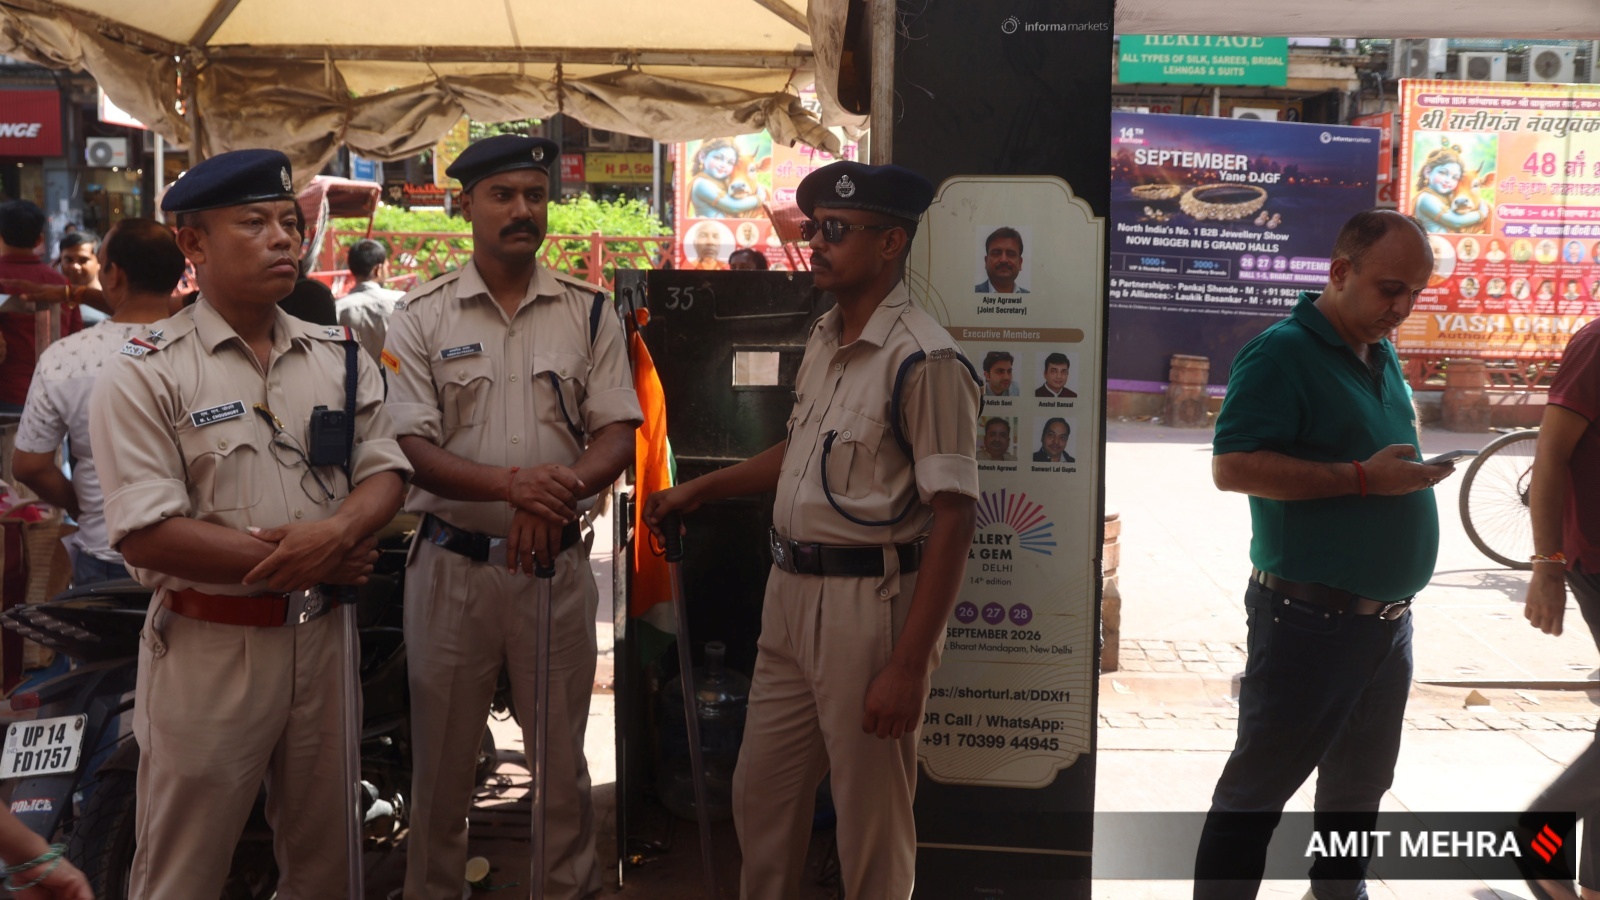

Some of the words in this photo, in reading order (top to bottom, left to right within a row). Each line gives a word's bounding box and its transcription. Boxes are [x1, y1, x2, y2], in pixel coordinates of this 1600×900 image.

[1144, 34, 1264, 48] HERITAGE
[1122, 54, 1138, 62] ALL
[1141, 54, 1170, 63] TYPES
[1172, 54, 1184, 63] OF
[1186, 55, 1210, 65] SILK,
[1212, 56, 1249, 66] SAREES,
[1252, 56, 1284, 66] BRIDAL
[1164, 66, 1206, 75] LEHNGAS
[1208, 67, 1215, 75] &
[1218, 67, 1244, 76] SUITS
[1420, 110, 1444, 129] श्री
[1450, 111, 1521, 132] रानीगंज
[1134, 148, 1248, 170] SEPTEMBER
[1523, 152, 1556, 176] 48
[606, 164, 614, 174] H
[620, 164, 628, 174] P
[634, 163, 653, 174] So
[1220, 170, 1246, 182] Yane
[1249, 172, 1281, 184] DJGF
[1117, 223, 1143, 232] North
[1145, 224, 1174, 234] India's
[1175, 226, 1191, 236] No.
[1193, 228, 1198, 236] 1
[1200, 228, 1218, 237] B2B
[1220, 229, 1261, 240] Jewellery
[1263, 231, 1289, 240] Show
[1126, 236, 1150, 245] NOW
[1152, 238, 1190, 248] BIGGER
[1190, 239, 1202, 248] IN
[1204, 240, 1210, 248] 5
[1212, 240, 1246, 250] GRAND
[1248, 242, 1280, 252] HALLS
[1241, 258, 1254, 267] 26
[1256, 258, 1270, 268] 27
[1274, 259, 1286, 268] 28
[1290, 260, 1330, 271] SEPTEMB
[1178, 282, 1206, 293] Pankaj
[1207, 284, 1238, 294] Shende
[1245, 286, 1254, 294] M
[1262, 288, 1278, 296] +91
[665, 286, 695, 310] 35
[982, 296, 996, 304] Ajay
[998, 297, 1022, 306] Agrawal
[1110, 290, 1120, 298] ng
[1122, 289, 1128, 297] &
[1175, 292, 1203, 301] Laukik
[1204, 294, 1242, 304] Basankar
[1266, 298, 1282, 306] +91
[977, 306, 994, 314] [Joint
[996, 307, 1027, 316] Secretary]
[1434, 314, 1506, 332] YASH
[1513, 316, 1591, 334] ORNA
[962, 329, 1000, 338] Executive
[1003, 330, 1040, 339] Members
[972, 534, 1013, 545] LLERY
[980, 548, 1012, 560] GEM
[982, 564, 1012, 572] DELHI
[986, 578, 1012, 586] edition
[959, 608, 974, 617] 26
[986, 608, 1000, 618] 27
[1013, 609, 1028, 619] 28
[946, 628, 1008, 640] SEPTEMBER
[1010, 630, 1042, 640] 2026
[950, 642, 977, 650] Bharat
[978, 643, 1028, 654] Mandapam,
[1030, 645, 1049, 654] New
[1052, 645, 1072, 654] Delhi
[930, 686, 1070, 702] ps://shorturl.at/DDXf1
[944, 713, 972, 726] Call
[976, 714, 982, 727] /
[986, 714, 1064, 732] WhatsApp:
[22, 725, 44, 748] UP
[48, 723, 66, 745] 14
[922, 732, 950, 746] +91
[957, 733, 1005, 748] 70399
[1010, 736, 1059, 750] 44945
[12, 746, 72, 773] FD1757
[10, 799, 52, 813] POLICE
